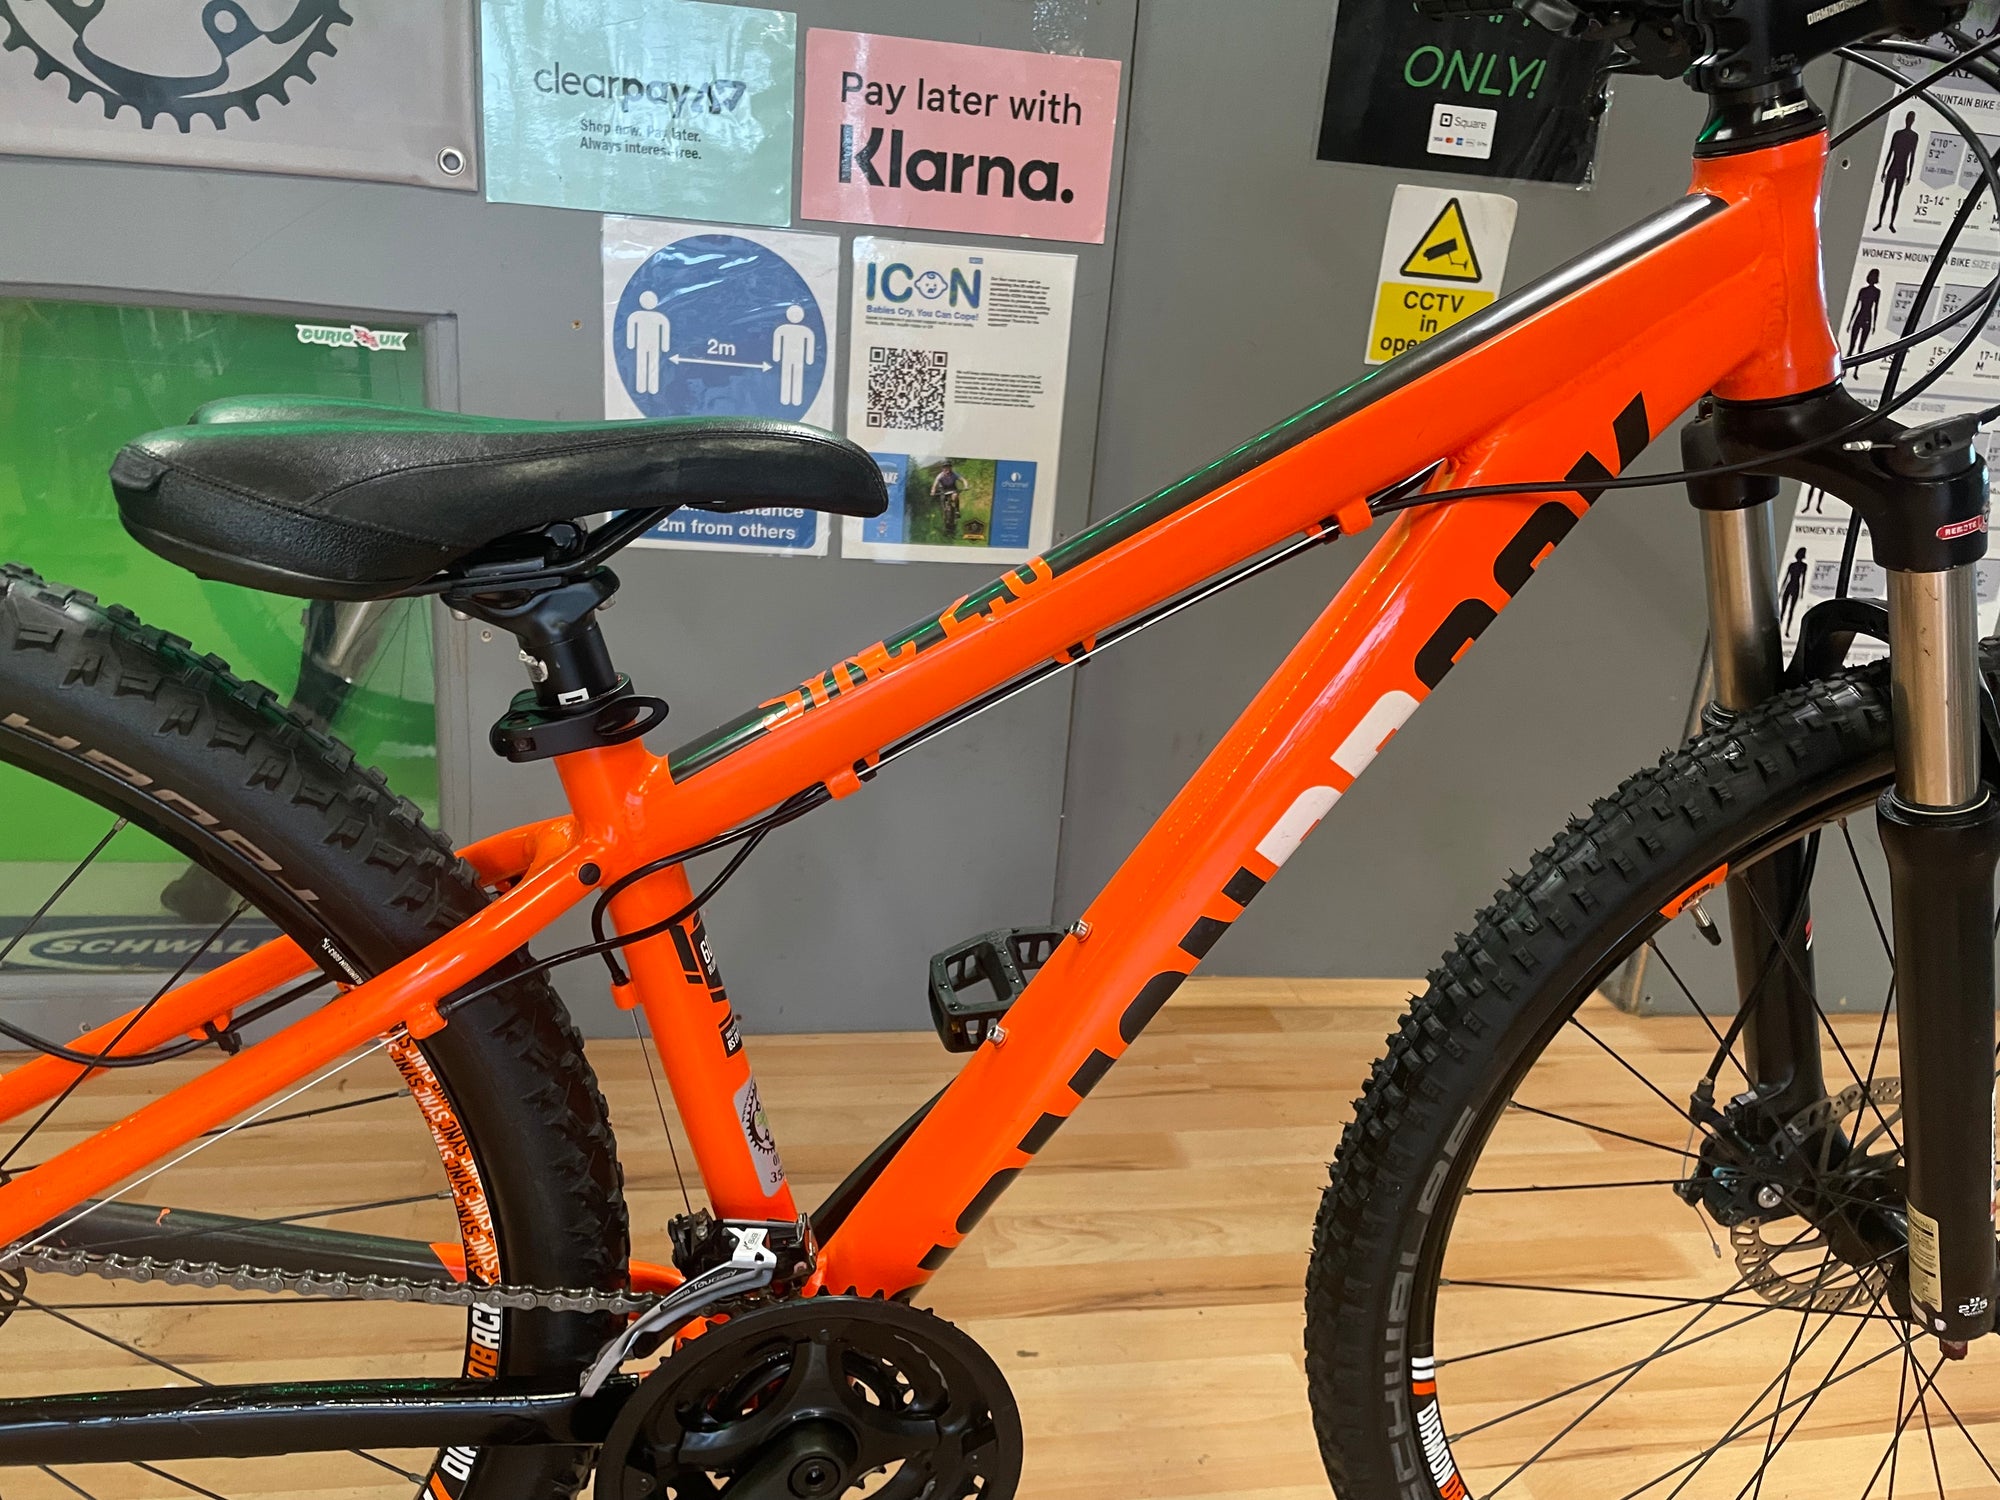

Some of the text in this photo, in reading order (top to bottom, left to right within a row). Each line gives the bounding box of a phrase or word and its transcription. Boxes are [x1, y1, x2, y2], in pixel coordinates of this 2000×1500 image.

[1404, 45, 1547, 99] ONLY!
[533, 62, 690, 118] clearpay
[841, 71, 1082, 126] Pay later with
[1974, 98, 1996, 110] BIKE
[581, 118, 611, 135] Shop
[671, 127, 702, 142] later.
[1454, 116, 1488, 131] Square
[580, 137, 622, 154] Always
[838, 124, 1074, 204] Klarna.
[1915, 205, 1928, 216] XS
[1862, 248, 1903, 260] WOMEN'S
[1951, 258, 1971, 268] BIKE
[866, 305, 979, 321] Babies Cry, You Can Cope!
[1403, 291, 1464, 313] CCTV
[1420, 314, 1438, 333] in
[301, 328, 403, 347] CURIO UK
[707, 338, 736, 357] 2m
[1976, 362, 1985, 371] M
[657, 518, 796, 540] 2m from others
[413, 1087, 450, 1117] SYNC
[438, 1120, 469, 1154] SYNC
[445, 1161, 478, 1191] SYNC
[469, 1234, 499, 1270] SYNC
